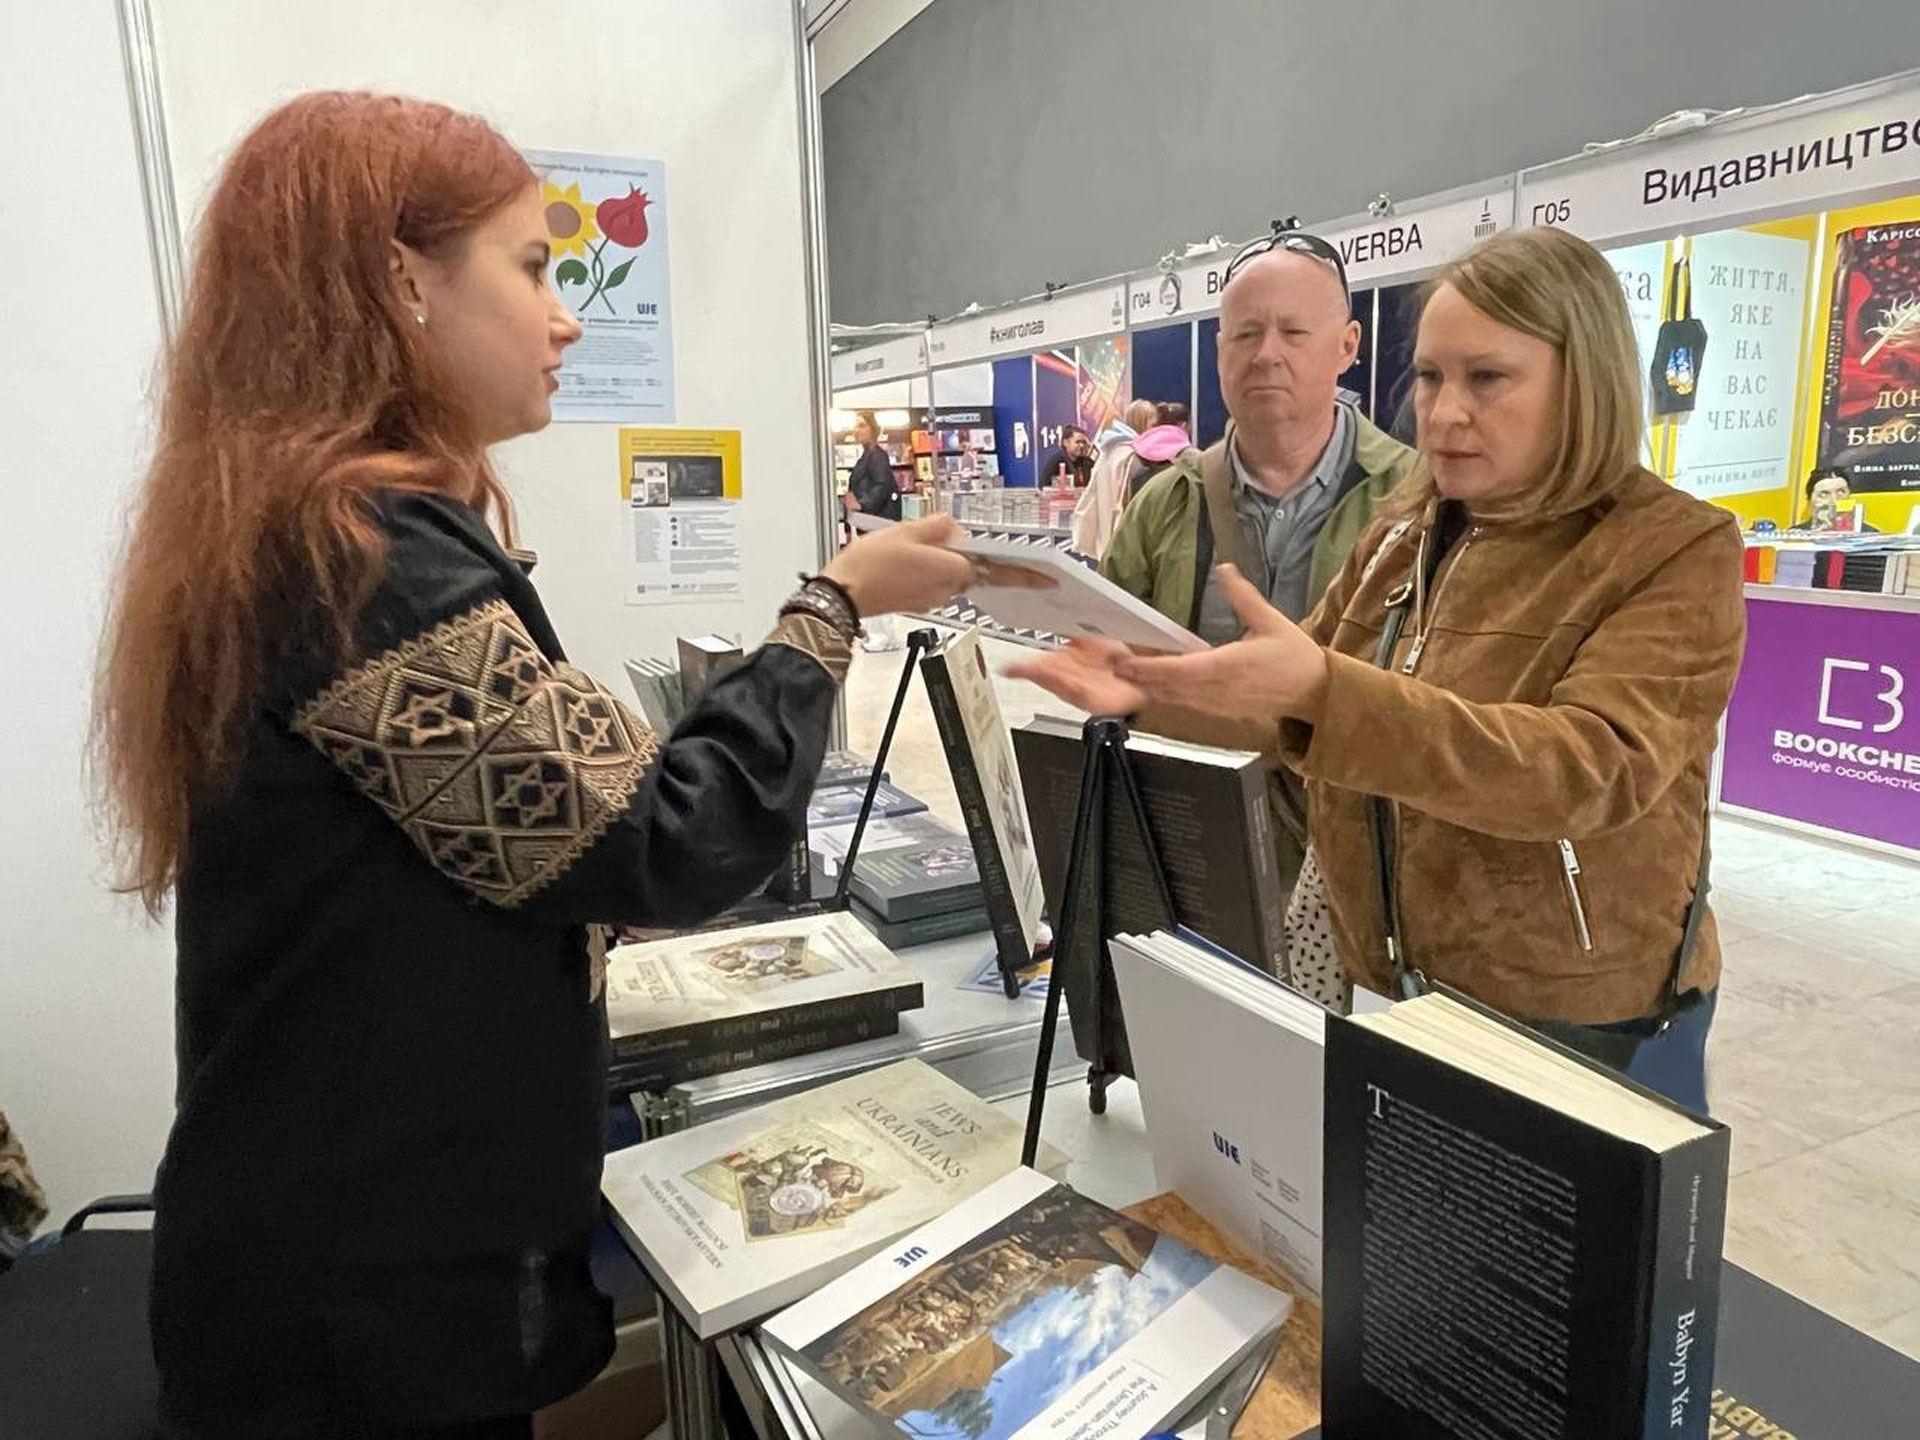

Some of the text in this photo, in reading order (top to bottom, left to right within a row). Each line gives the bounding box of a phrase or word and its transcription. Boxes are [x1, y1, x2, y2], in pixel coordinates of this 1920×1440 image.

[1340, 223, 1423, 265] VERBA
[1708, 264, 1795, 295] ЖИТТЯ,
[1730, 302, 1774, 327] ЯКЕ
[990, 319, 1045, 344] #книголав
[1734, 338, 1763, 361] НА
[1727, 374, 1767, 396] ВАС
[1708, 407, 1778, 432] ЧЕКАЄ
[914, 1116, 956, 1137] and
[928, 1100, 983, 1135] JEWS
[856, 1097, 970, 1178] UKRAINIANS
[1668, 1307, 1696, 1429] Babyn Yar
